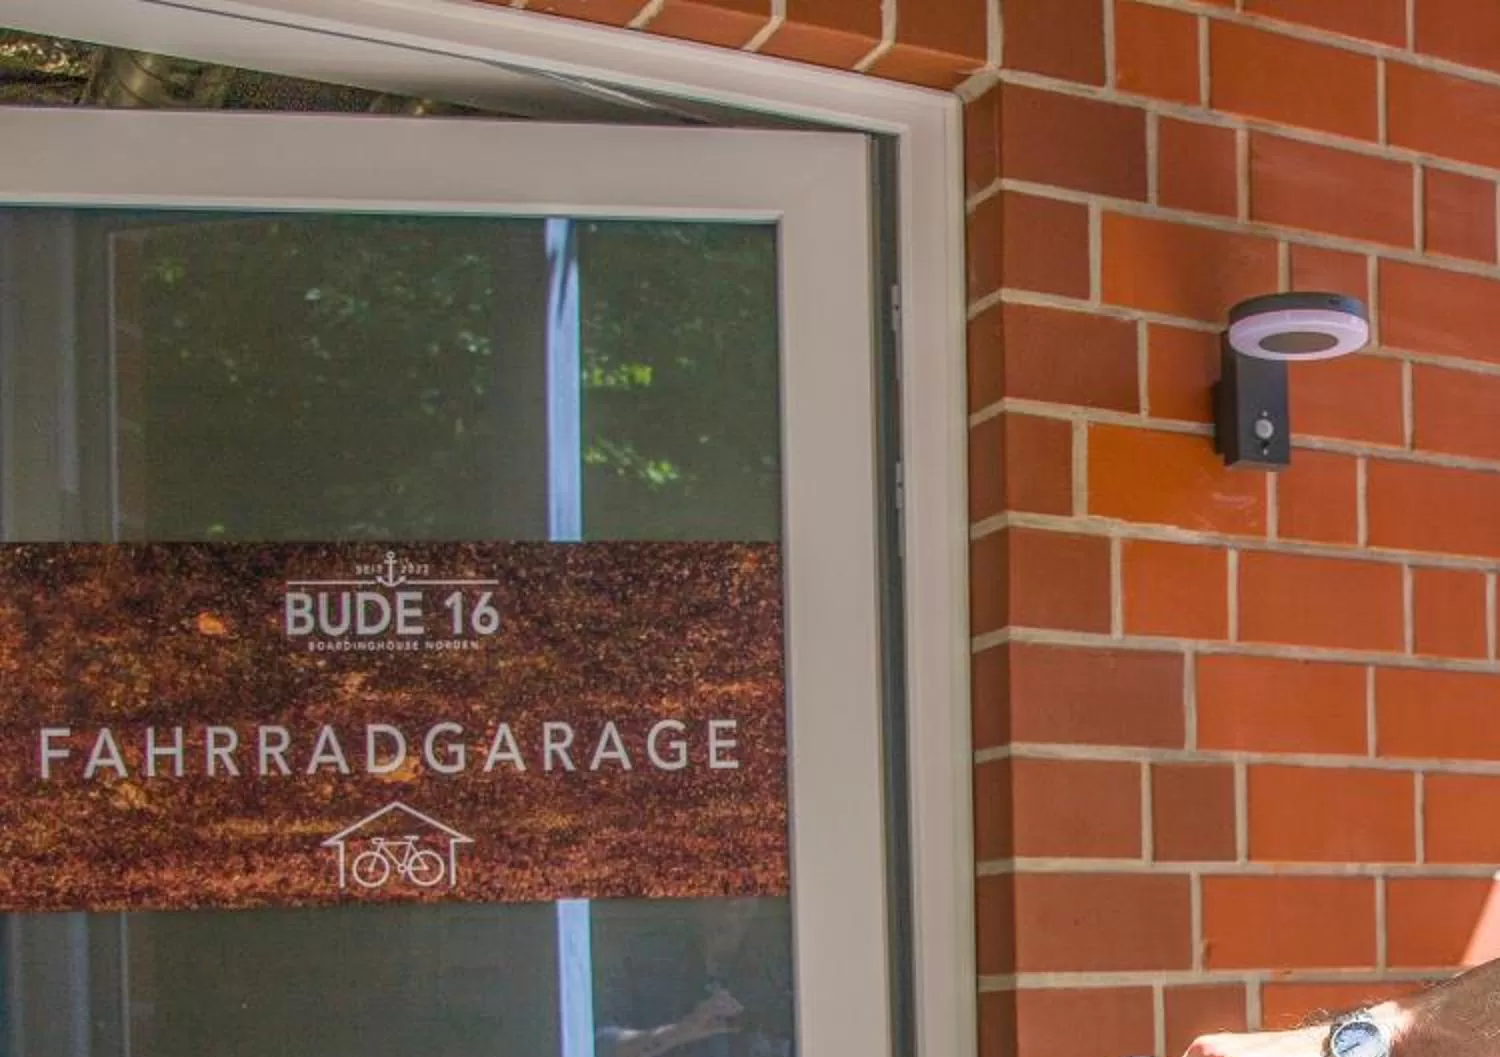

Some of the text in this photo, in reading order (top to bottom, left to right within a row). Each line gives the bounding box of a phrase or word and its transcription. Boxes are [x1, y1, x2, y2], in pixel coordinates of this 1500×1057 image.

[285, 590, 500, 636] BUDE 16
[308, 639, 480, 652] BOARDINGHOUSE NORDEN
[38, 719, 740, 780] FAHRRADGARAGE
